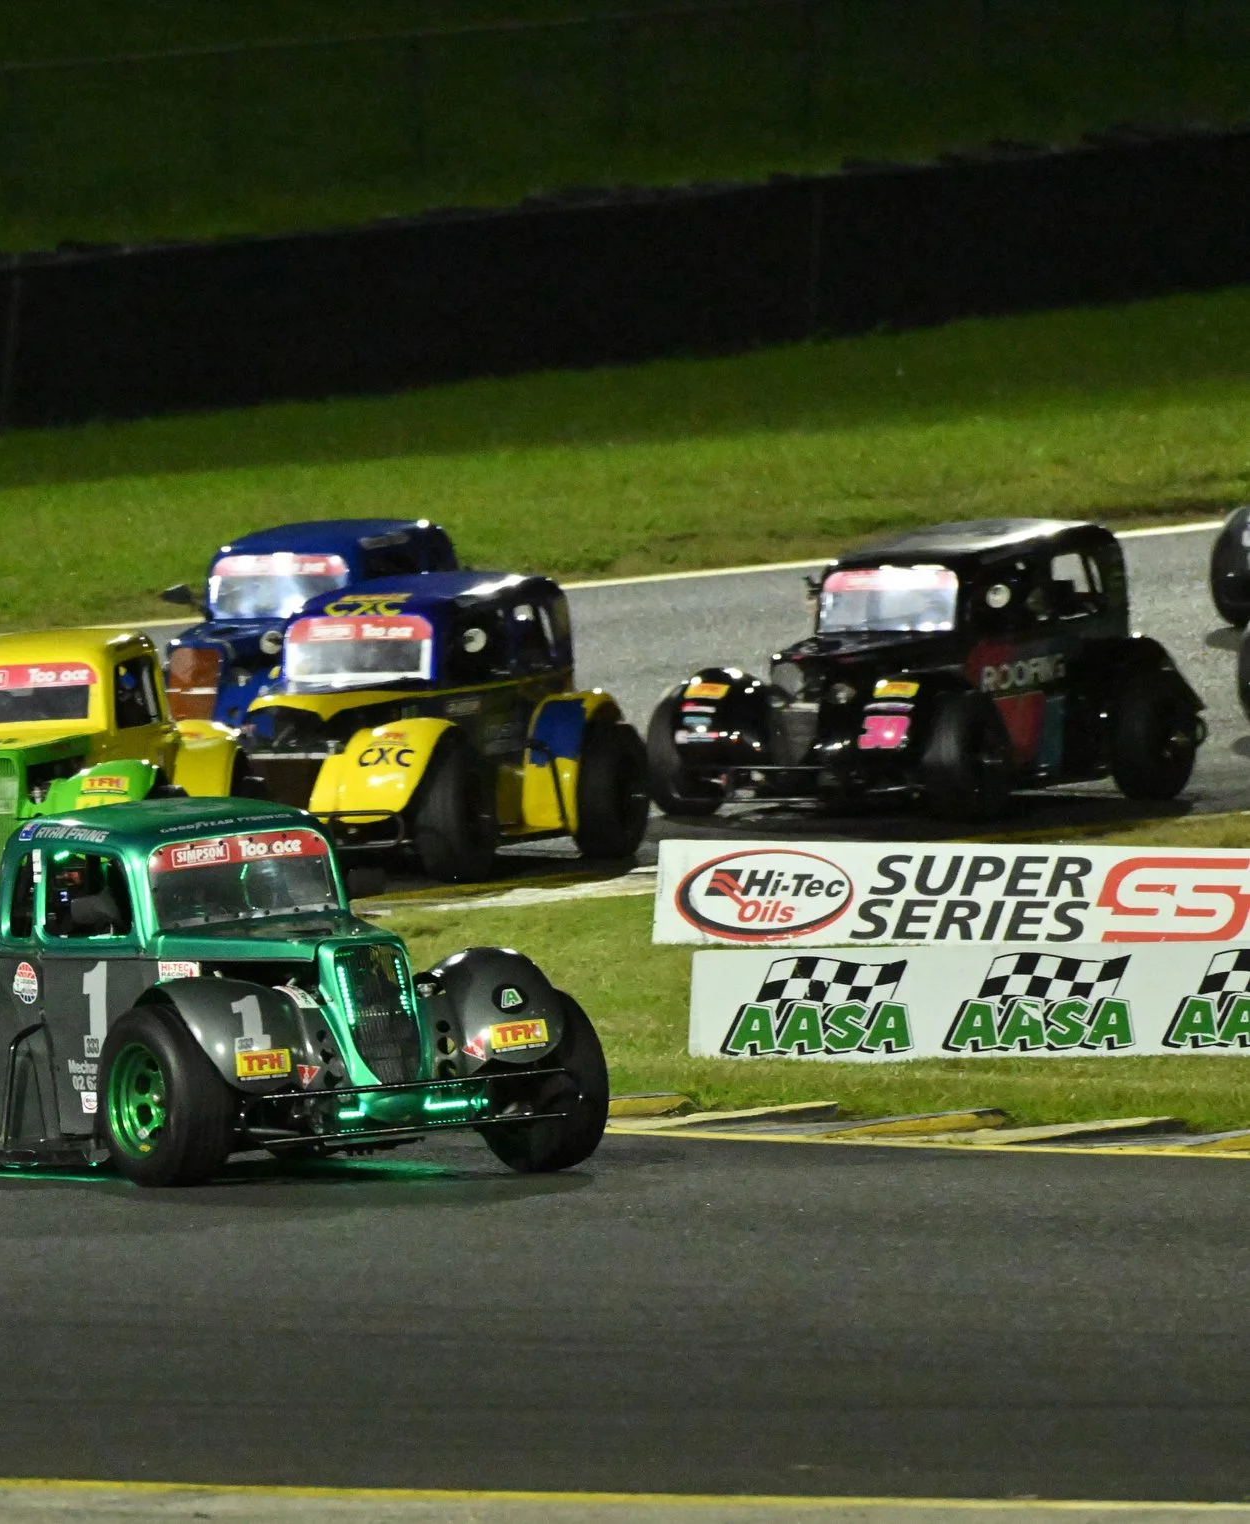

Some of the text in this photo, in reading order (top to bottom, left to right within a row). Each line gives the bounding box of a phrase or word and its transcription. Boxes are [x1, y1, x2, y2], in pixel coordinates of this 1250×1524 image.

[323, 598, 401, 616] CXC
[358, 747, 415, 767] CXC
[66, 828, 110, 843] PRING
[176, 844, 225, 862] SIMPSON
[741, 869, 845, 898] Hi-Tec
[868, 854, 1093, 898] SUPER
[737, 900, 796, 923] Oils
[849, 898, 1091, 943] SERIES
[161, 963, 189, 972] HI-TEC
[231, 995, 271, 1051] 1
[497, 1022, 540, 1043] TFH
[721, 999, 914, 1055] AASA
[942, 996, 1136, 1052] AASA
[243, 1054, 283, 1072] TFH
